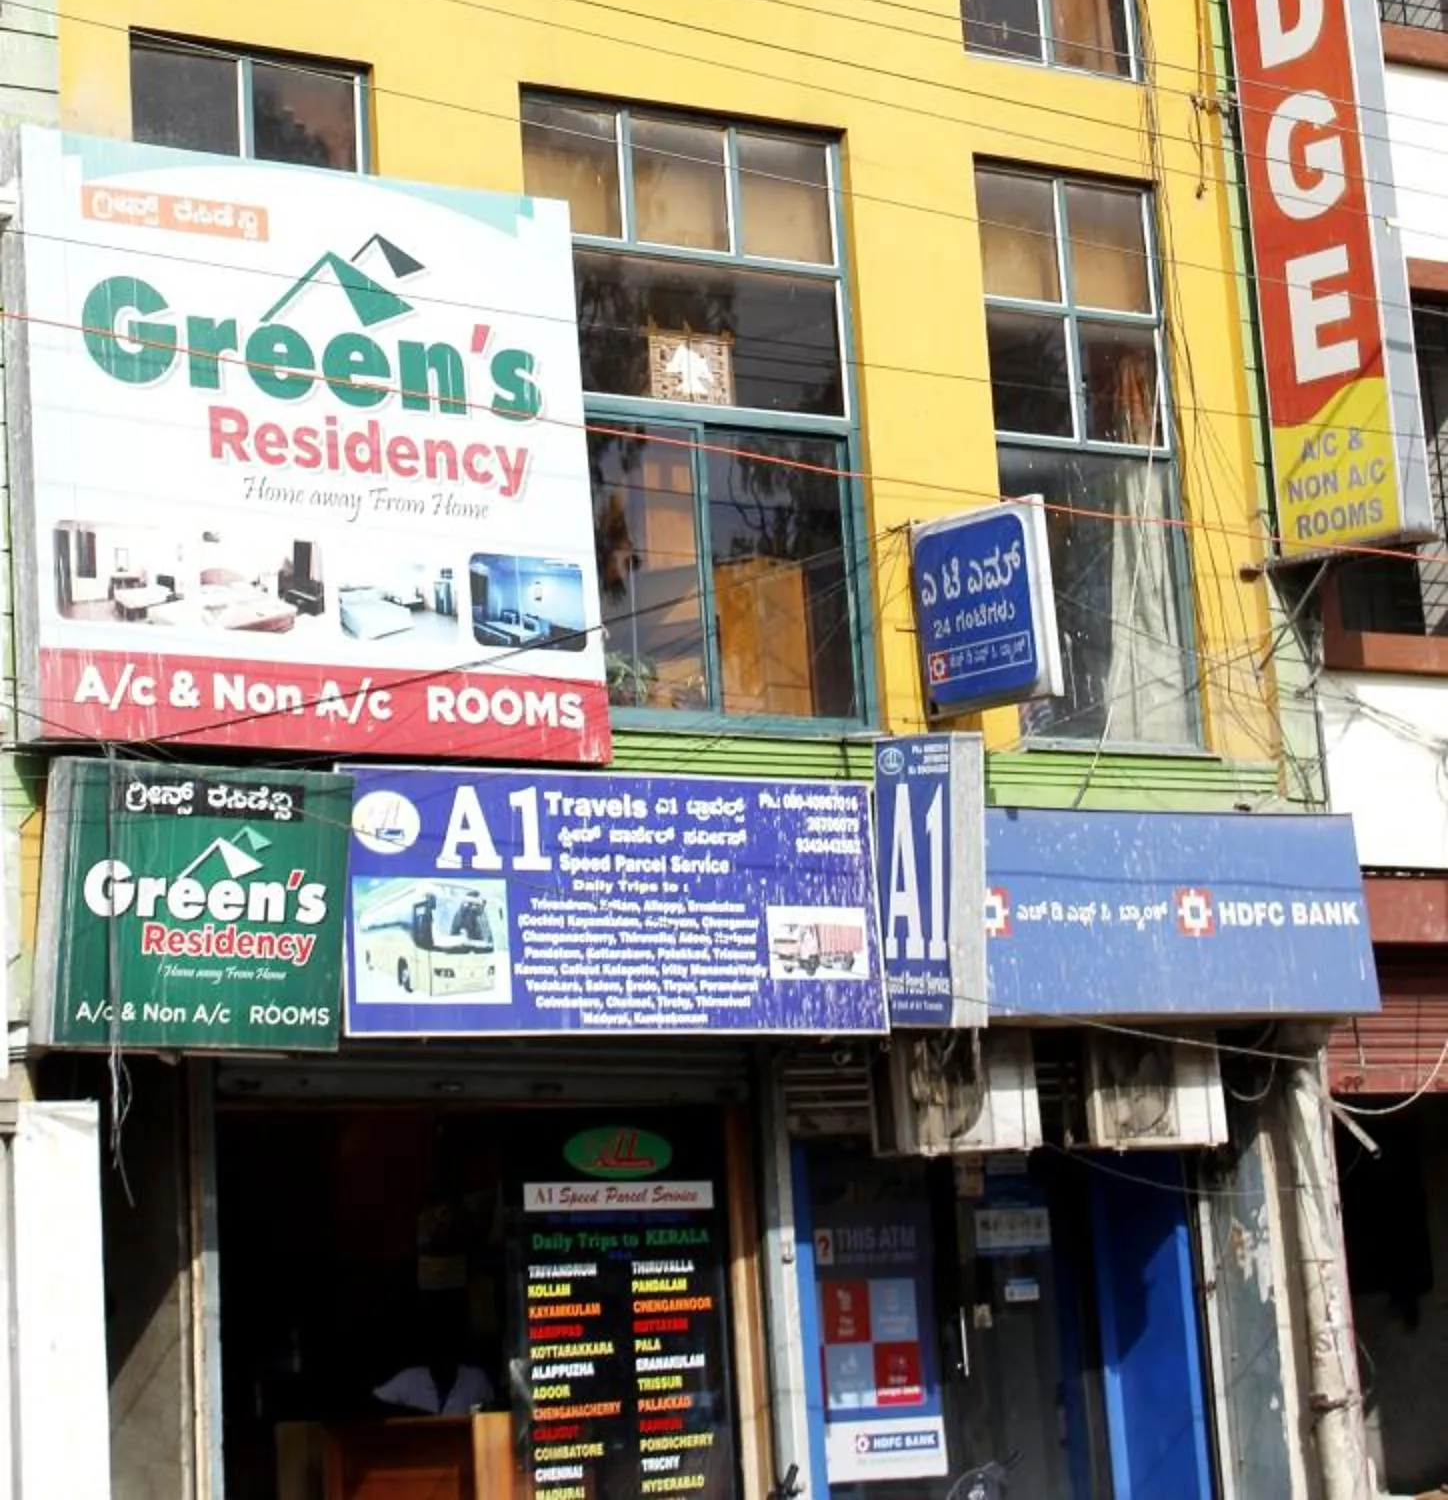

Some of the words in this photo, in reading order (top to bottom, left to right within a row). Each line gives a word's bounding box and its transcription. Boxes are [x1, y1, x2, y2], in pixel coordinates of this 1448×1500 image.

[82, 275, 543, 421] Green's
[208, 405, 529, 498] Residency
[1301, 426, 1338, 463] A/C
[1348, 426, 1363, 451] &
[1288, 471, 1339, 504] NON
[1348, 457, 1387, 488] A/C
[243, 476, 303, 505] Home
[310, 490, 362, 523] away
[369, 488, 425, 515] From
[431, 493, 490, 519] Home
[1297, 499, 1384, 539] ROOMS
[933, 617, 952, 639] 24
[75, 664, 155, 708] A/c
[169, 670, 200, 709] &
[214, 673, 302, 716] Non
[315, 678, 394, 725] A/c
[427, 686, 585, 731] ROOMS
[544, 791, 648, 819] Travels
[436, 785, 552, 870] A1
[559, 853, 610, 874] Speed
[615, 854, 666, 873] Parcel
[671, 854, 730, 874] Service
[886, 783, 948, 960] A1
[84, 859, 327, 924] Green's
[573, 880, 614, 894] Daily
[618, 880, 658, 894] Trips
[663, 880, 679, 892] to
[1219, 901, 1285, 925] HDFC
[1292, 901, 1360, 926] BANK
[141, 921, 316, 966] Residency
[76, 1000, 114, 1022] A/c
[121, 1002, 137, 1021] &
[143, 1003, 186, 1023] Non
[192, 1003, 231, 1024] A/c
[250, 1005, 330, 1026] ROOMS
[559, 1185, 599, 1206] Speed
[604, 1186, 649, 1204] Parcel
[532, 1233, 573, 1253] Daily
[577, 1232, 619, 1252] Trips
[624, 1233, 640, 1248] to
[646, 1227, 710, 1246] KERALA
[835, 1227, 876, 1250] THIS
[877, 1225, 917, 1248] ATM
[528, 1283, 571, 1298] KOLLAM
[635, 1337, 662, 1353] PALA
[531, 1362, 596, 1380] ALAPPUZHA
[637, 1375, 683, 1392] TRISSUR
[532, 1384, 571, 1400] ADOOR
[639, 1432, 715, 1452] PONDICHERRY
[873, 1435, 902, 1450] HDFC
[905, 1433, 936, 1447] BANK
[535, 1464, 584, 1483] CHENNAI
[641, 1474, 705, 1493] HYDERABAD
